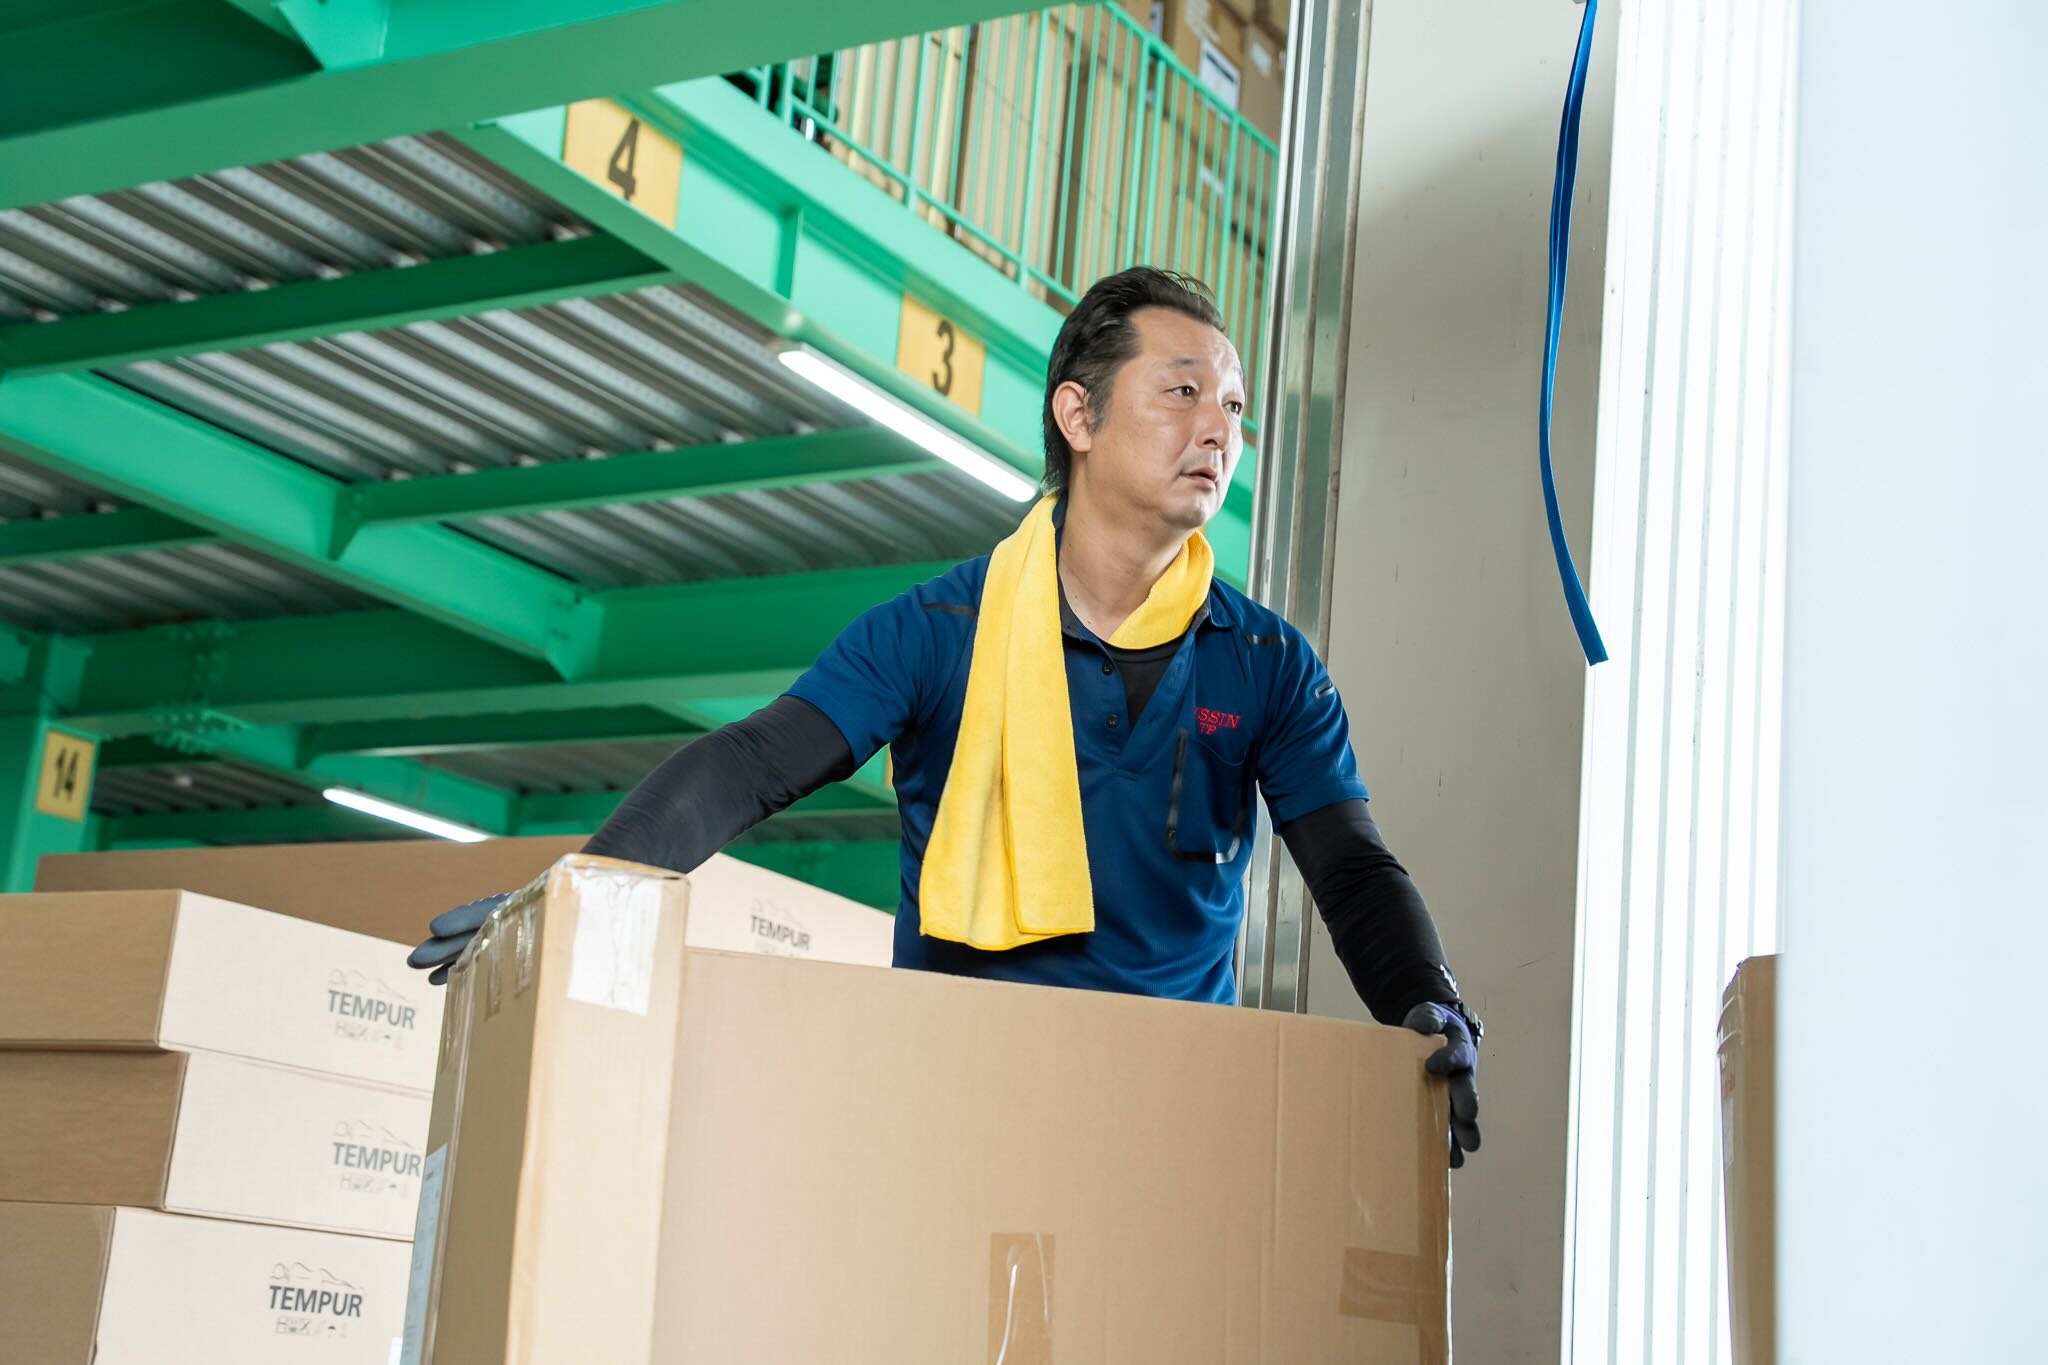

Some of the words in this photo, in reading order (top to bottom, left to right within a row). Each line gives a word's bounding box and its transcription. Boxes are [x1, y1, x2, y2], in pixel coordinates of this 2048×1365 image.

[607, 117, 640, 200] 4
[931, 318, 954, 397] 3
[750, 914, 811, 952] TEMPUR
[327, 989, 416, 1030] TEMPUR
[332, 1141, 422, 1176] TEMPUR
[269, 1284, 363, 1318] TEMPUR
